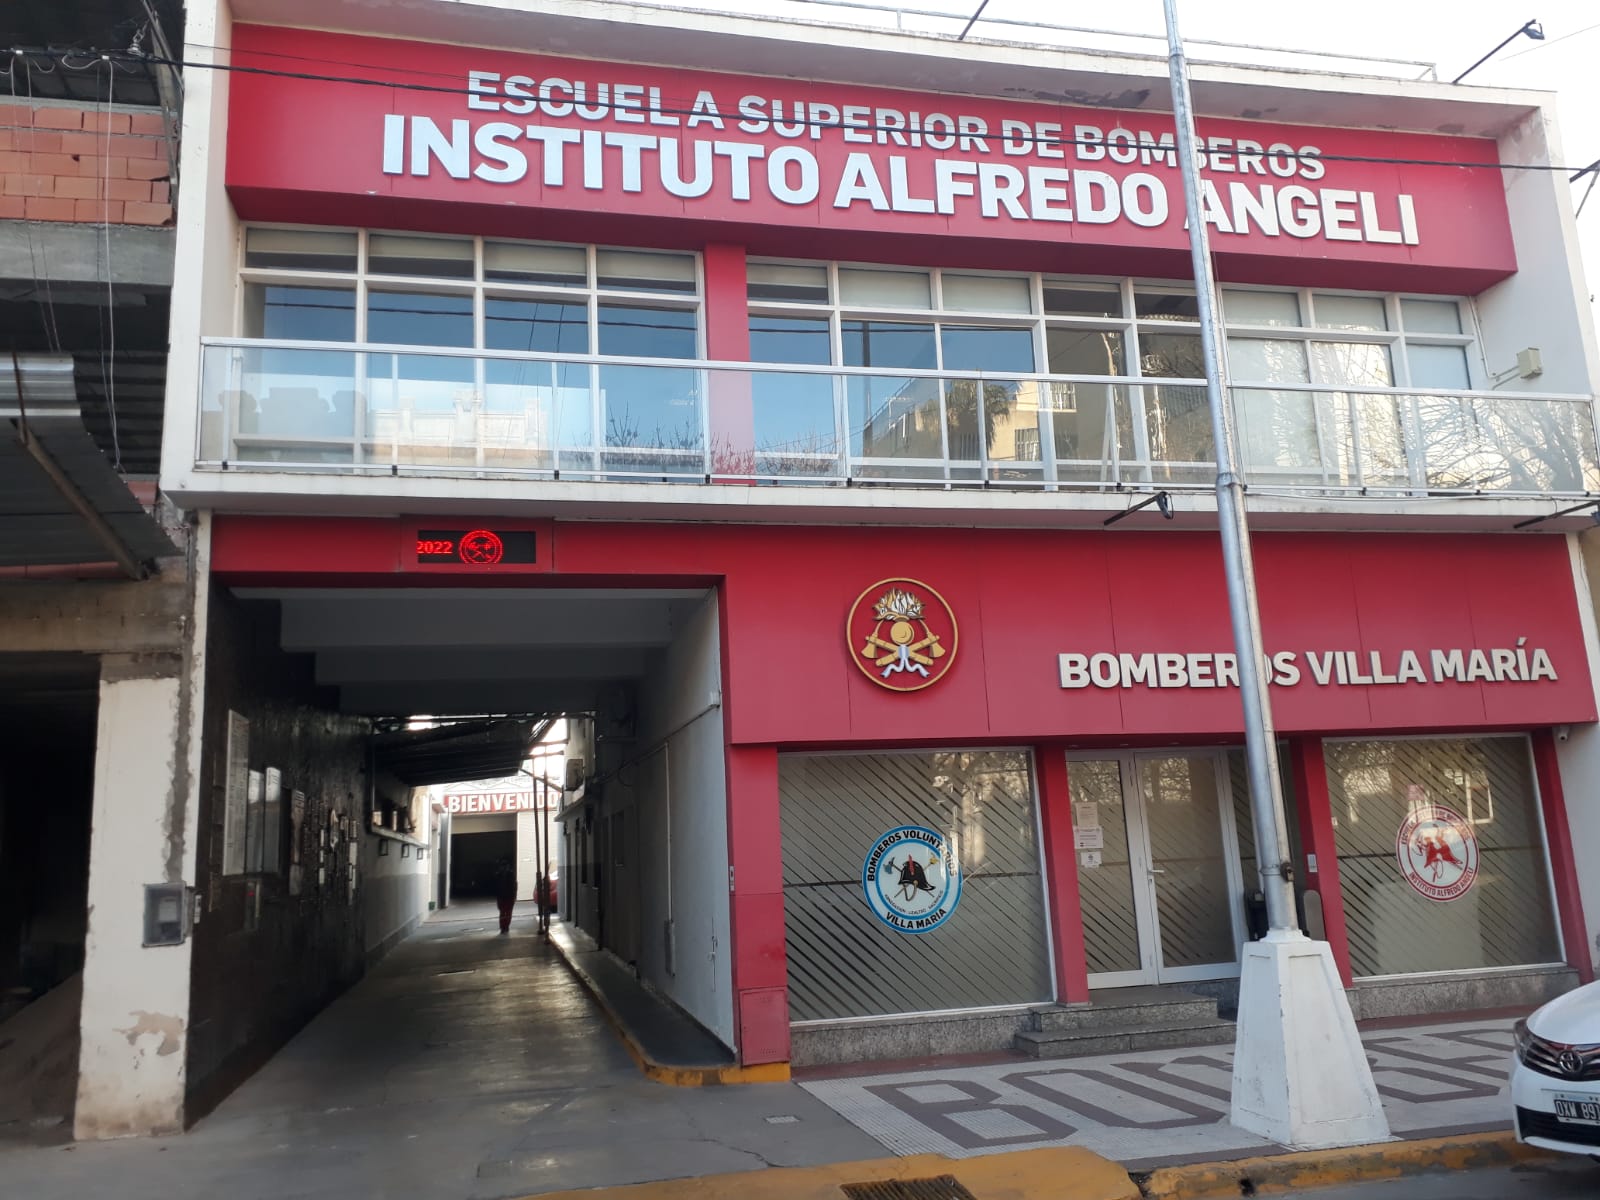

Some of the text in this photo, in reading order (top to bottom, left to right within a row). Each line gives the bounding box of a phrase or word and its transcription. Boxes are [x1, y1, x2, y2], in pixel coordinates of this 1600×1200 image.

[468, 70, 724, 129] ESCUELA
[738, 94, 990, 152] SUPERIOR
[1002, 119, 1064, 159] DE
[383, 114, 1419, 246] INSTITUTO ALFREDO ANGELI
[416, 540, 453, 554] 2022
[1058, 637, 1558, 688] BOMBERS VILLA MARÍA
[867, 832, 902, 881] BOMBEROS
[886, 908, 947, 929] VILLA MARIA
